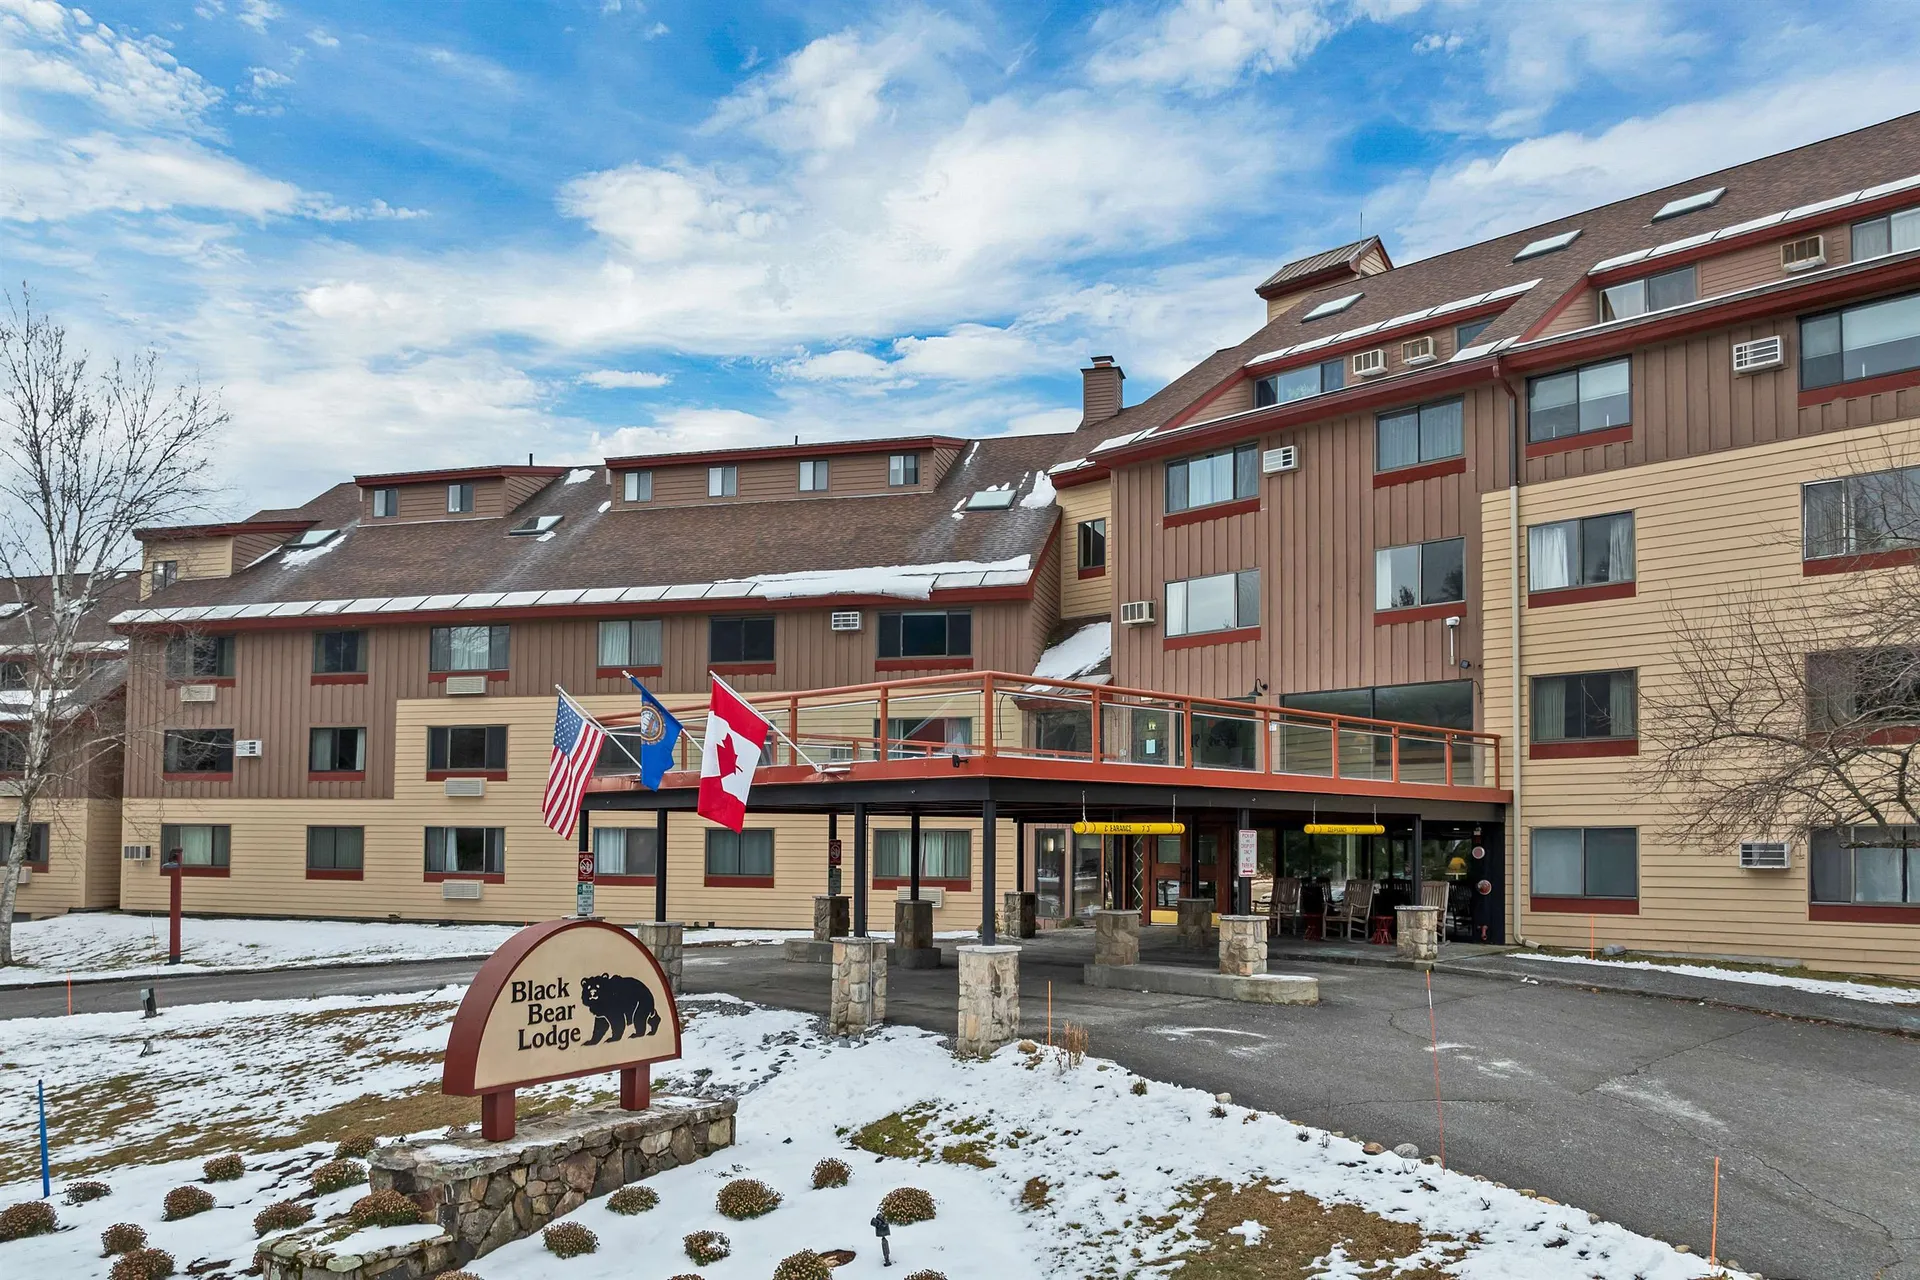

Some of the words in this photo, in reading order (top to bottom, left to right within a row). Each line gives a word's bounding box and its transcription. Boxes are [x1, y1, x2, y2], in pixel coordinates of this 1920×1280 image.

[1104, 824, 1132, 833] CEARANCE
[511, 977, 570, 1004] Black
[527, 1003, 576, 1026] Bear
[518, 1024, 581, 1051] Lodge
